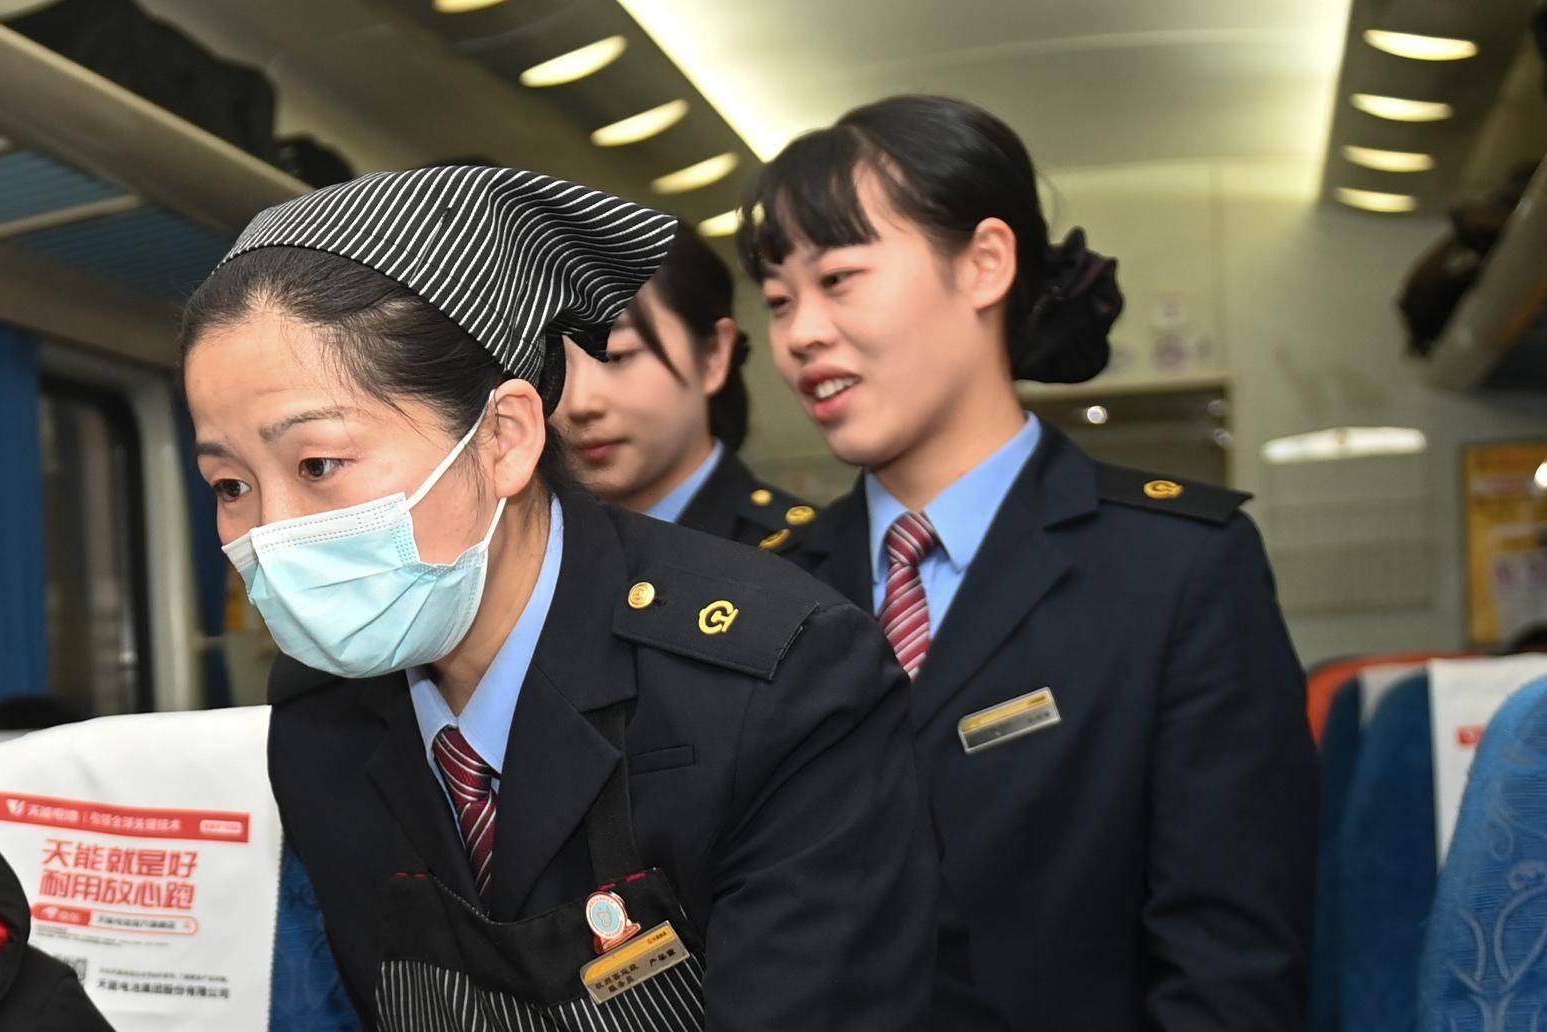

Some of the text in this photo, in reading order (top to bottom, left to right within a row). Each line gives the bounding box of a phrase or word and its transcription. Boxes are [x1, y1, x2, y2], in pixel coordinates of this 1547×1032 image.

[42, 838, 198, 878] 天能就是好
[40, 868, 195, 910] 耐用放心跑
